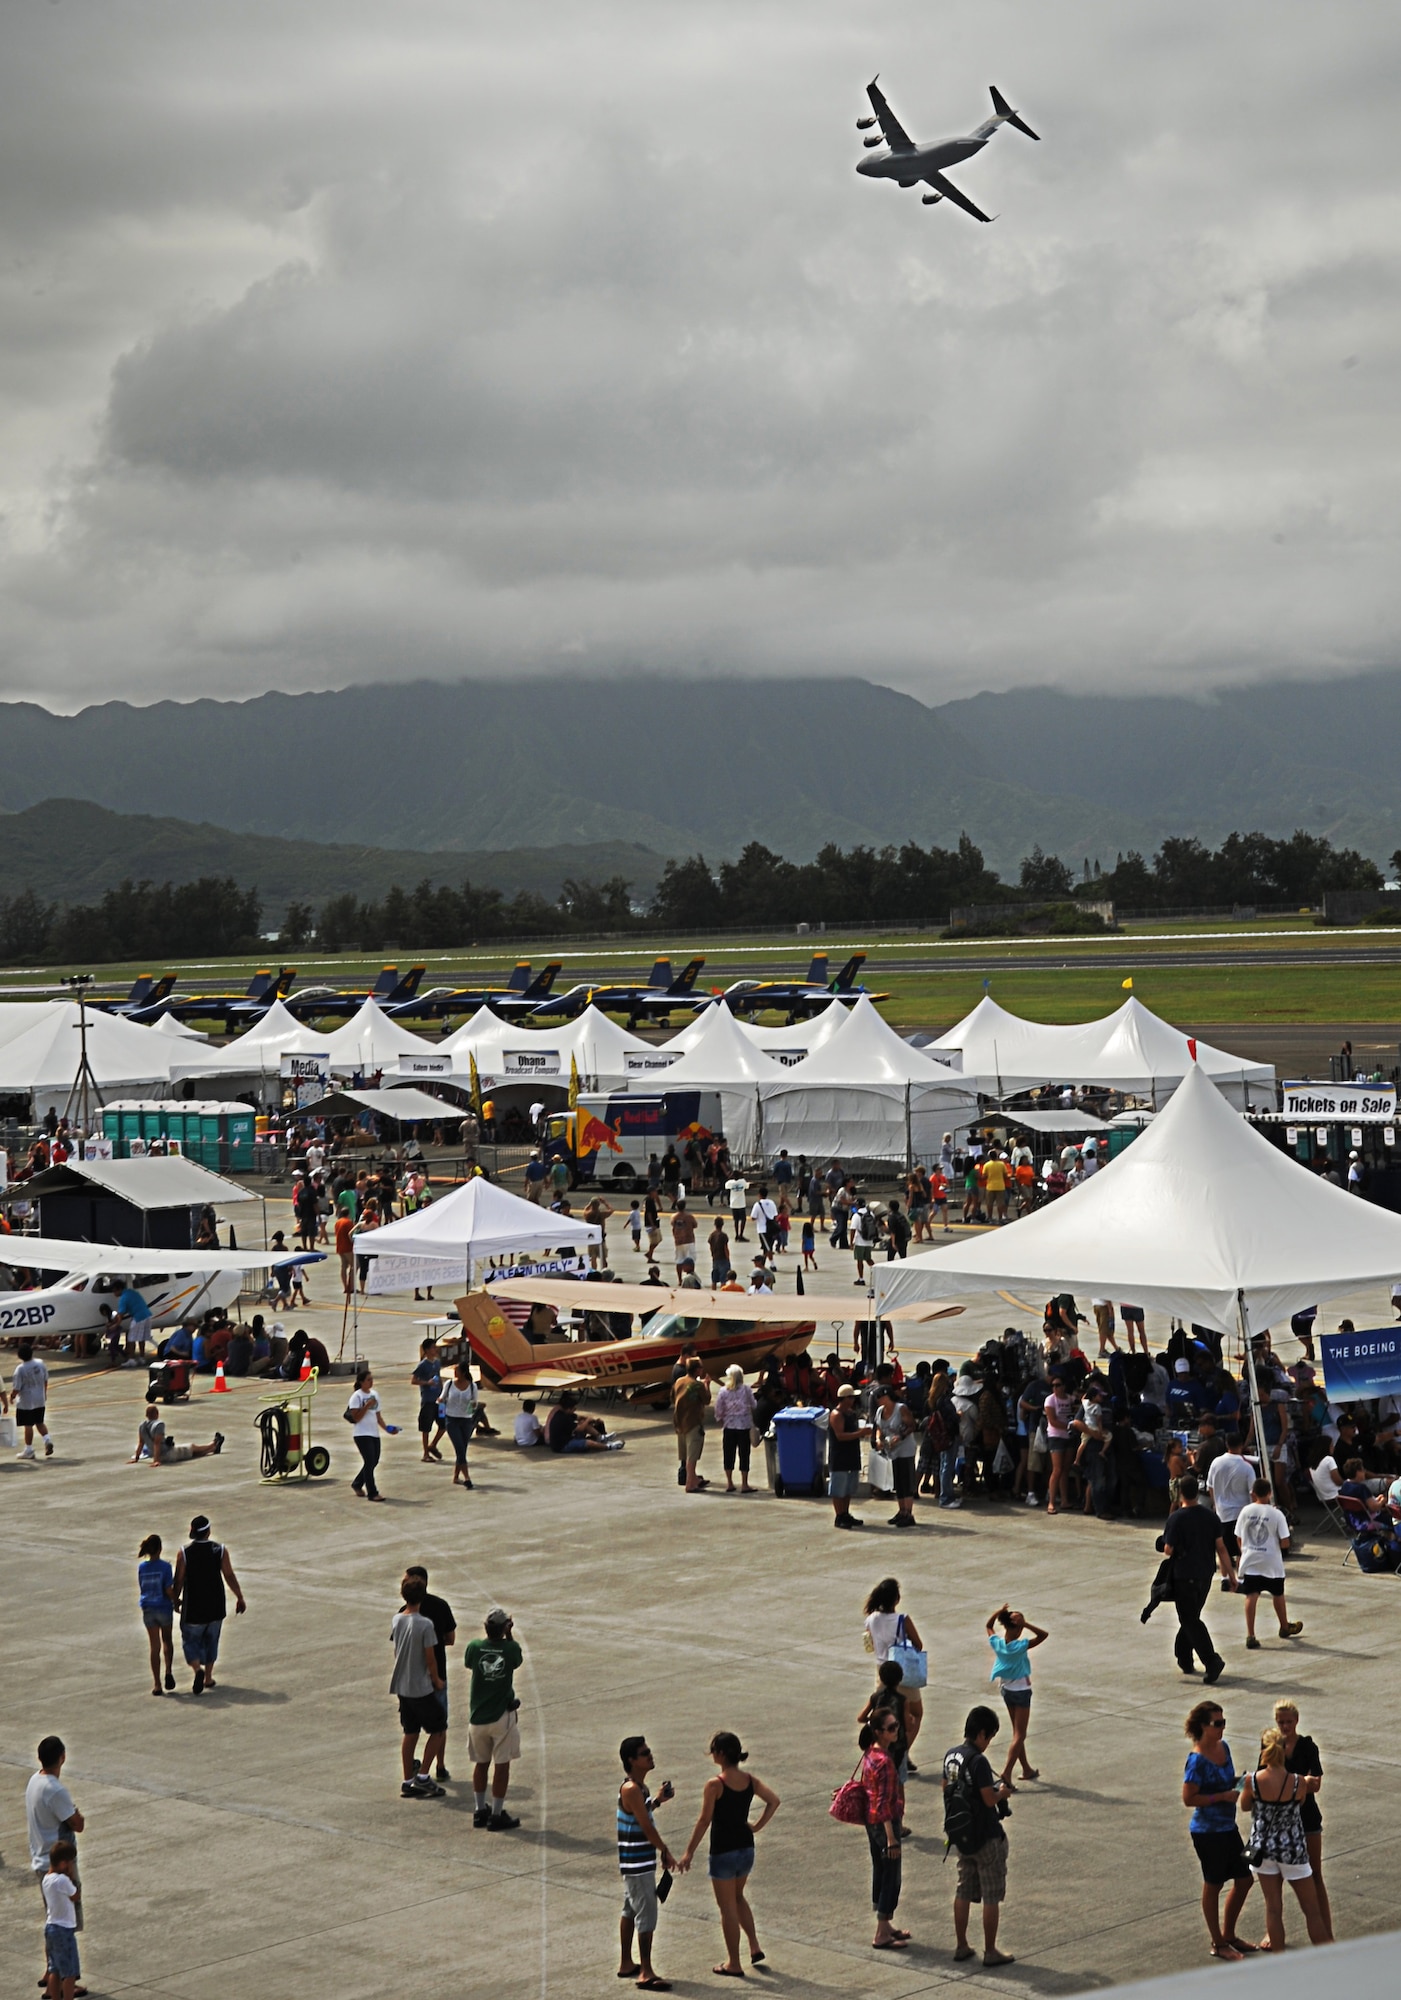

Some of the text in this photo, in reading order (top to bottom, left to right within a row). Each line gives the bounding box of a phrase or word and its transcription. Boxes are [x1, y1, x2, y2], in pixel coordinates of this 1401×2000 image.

[540, 973, 551, 987] 3
[684, 968, 696, 982] 2
[278, 979, 288, 992] 5
[404, 976, 415, 989] 4
[155, 983, 167, 996] 6
[291, 1059, 319, 1076] Media
[518, 1056, 546, 1066] Ohana
[628, 1060, 643, 1069] Clear
[644, 1060, 667, 1069] Channel
[505, 1066, 560, 1076] Broadcast Company
[1288, 1096, 1392, 1113] Tickets on Sale
[535, 1263, 547, 1274] TO
[0, 1304, 56, 1330] 22BP
[1329, 1340, 1396, 1359] THE BOEING
